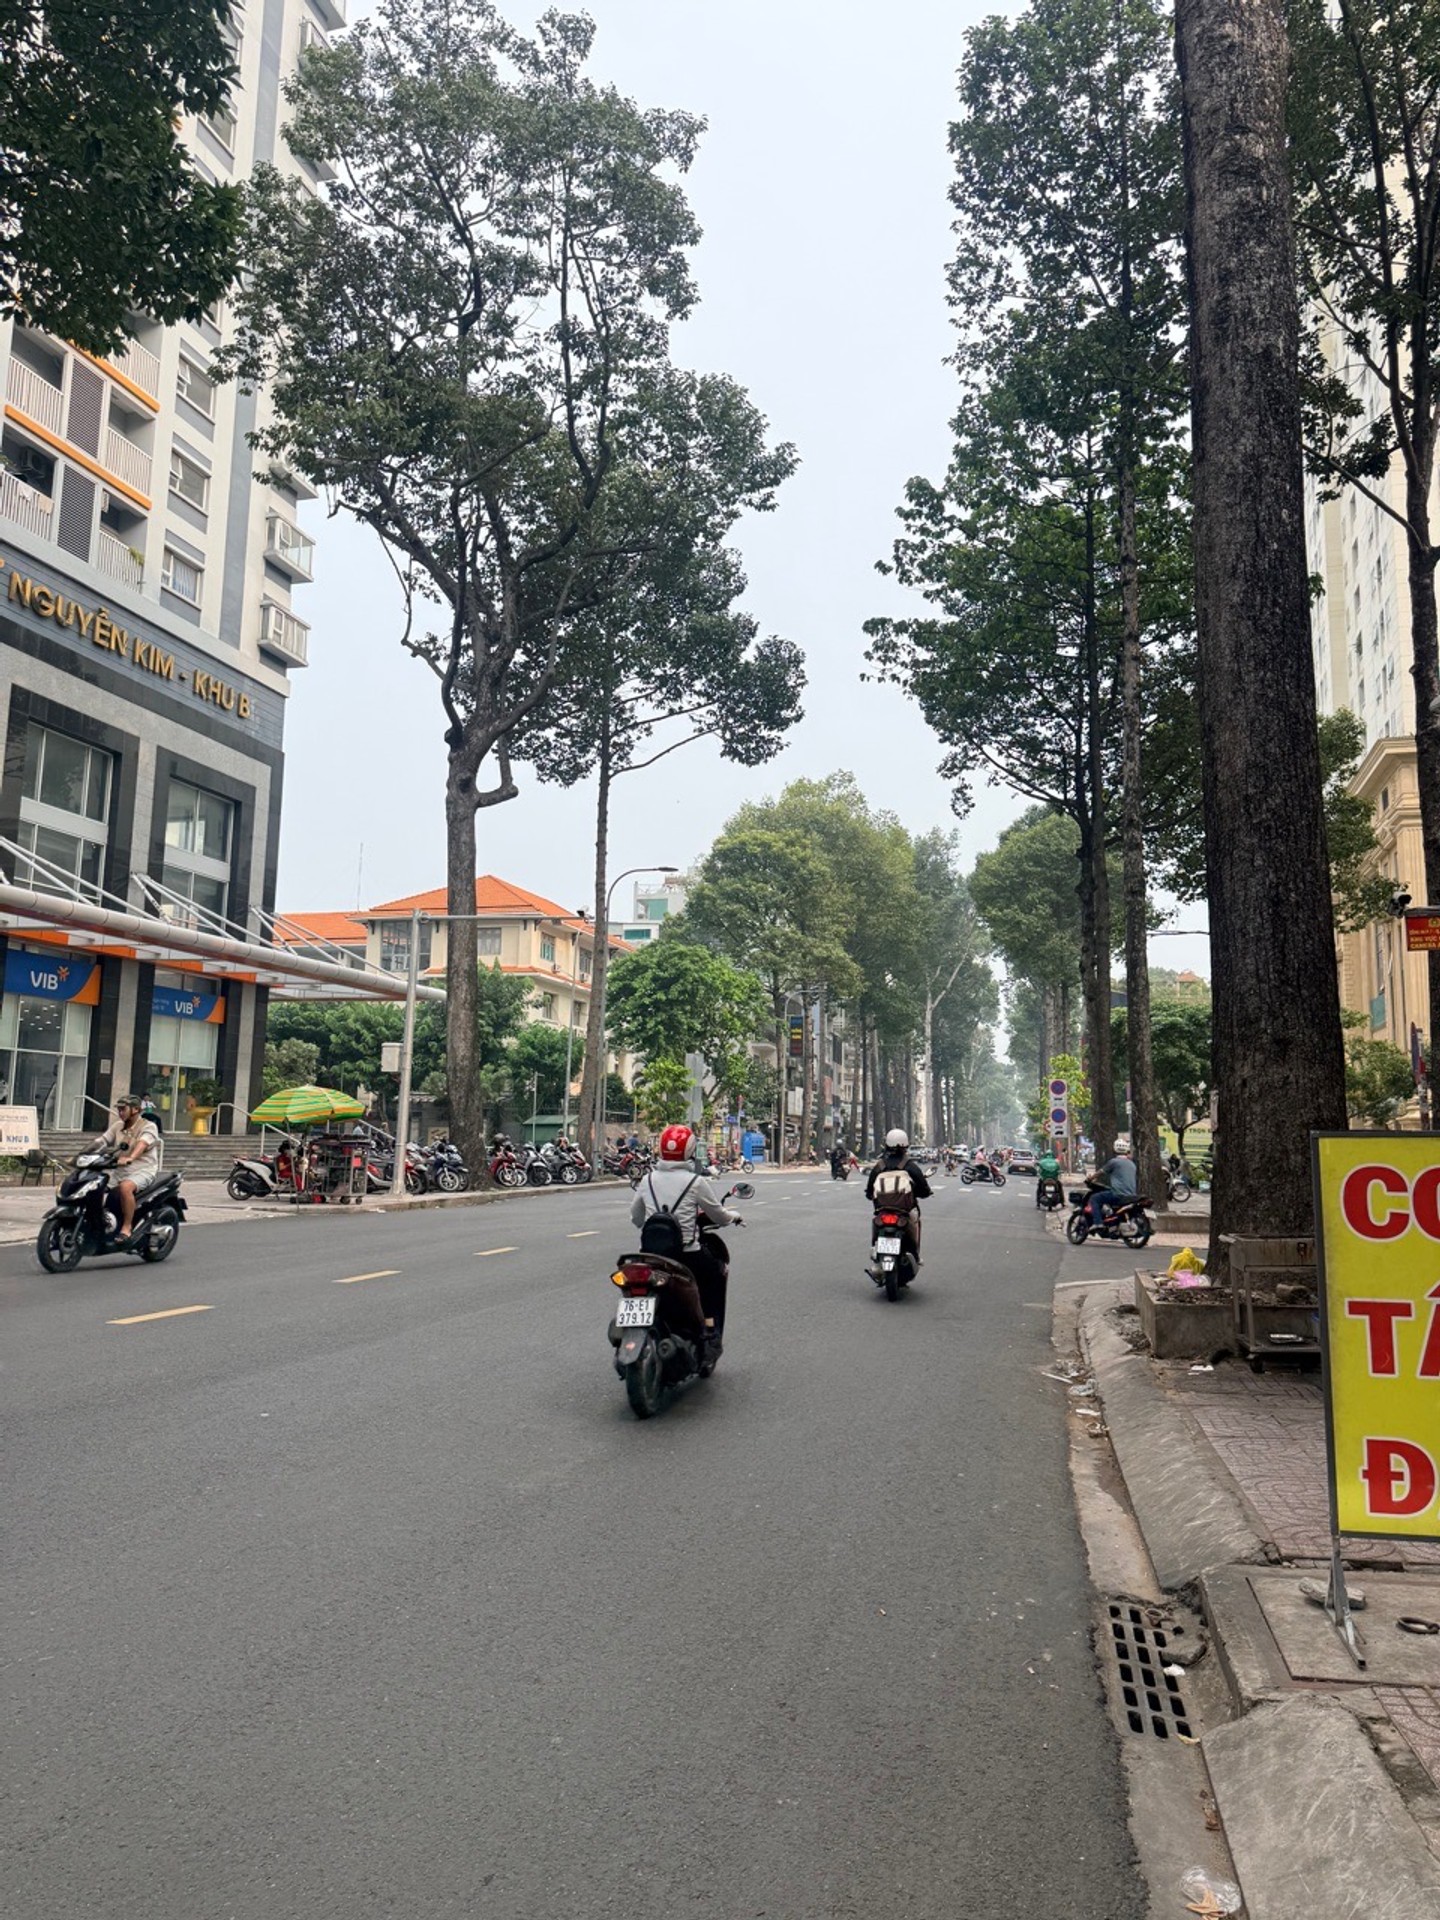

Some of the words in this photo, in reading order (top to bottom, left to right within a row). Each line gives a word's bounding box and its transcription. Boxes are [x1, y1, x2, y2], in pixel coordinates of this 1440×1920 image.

[133, 637, 175, 681] KIM
[193, 668, 235, 711] KHU
[238, 692, 251, 719] B
[30, 970, 59, 990] VIB
[174, 1000, 194, 1015] VIB
[624, 1299, 649, 1311] 76-E1
[619, 1312, 652, 1325] 379.12
